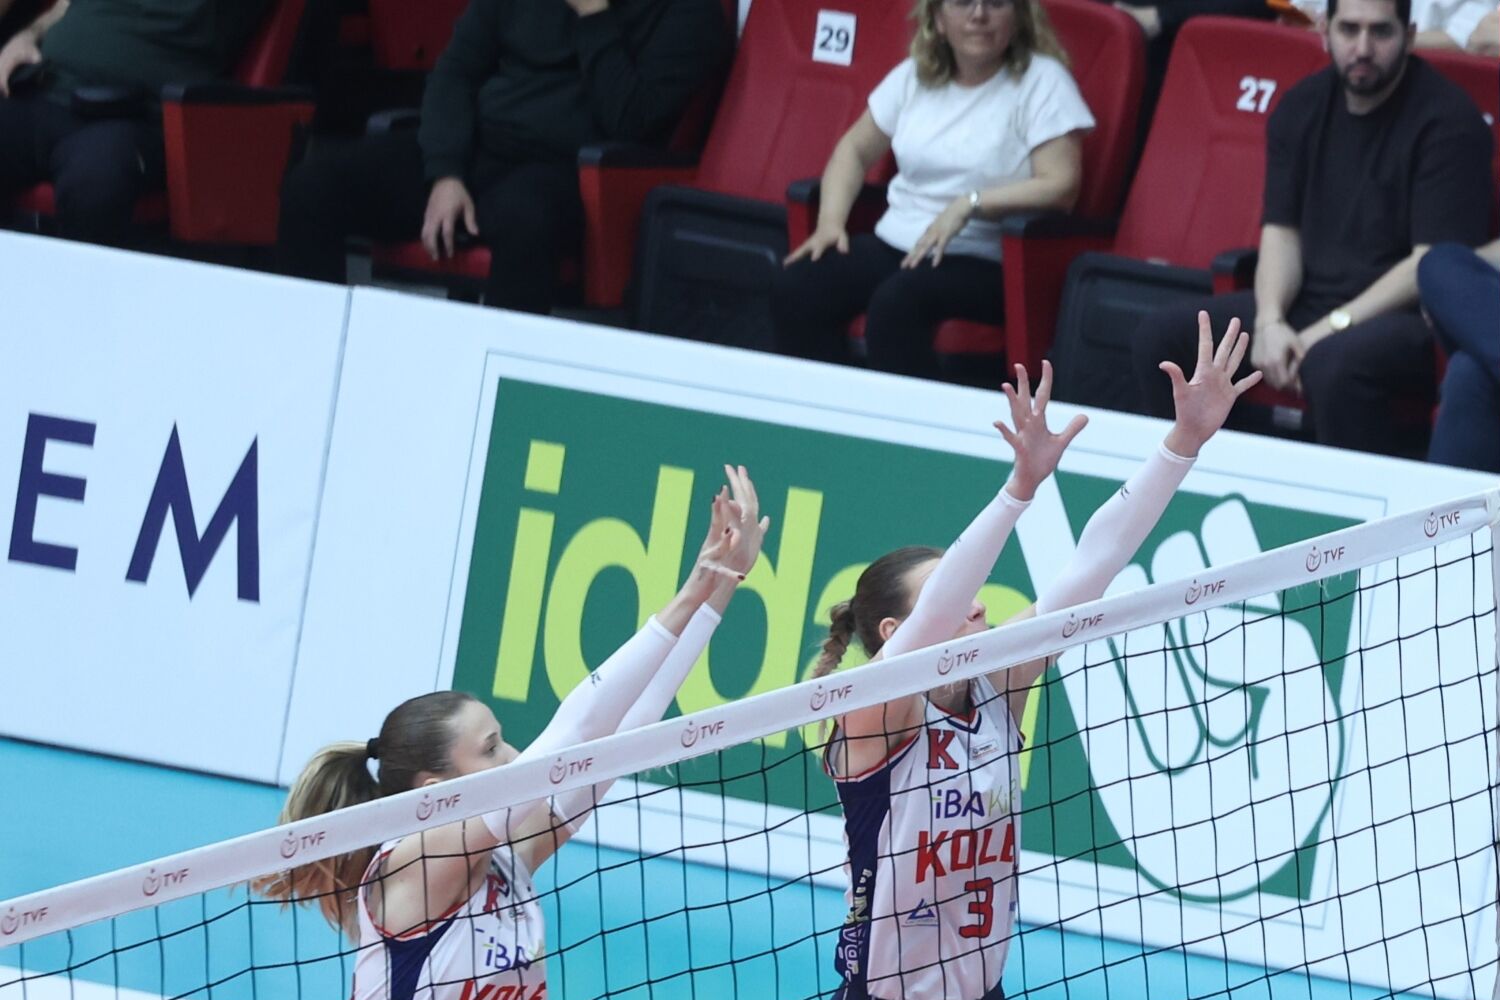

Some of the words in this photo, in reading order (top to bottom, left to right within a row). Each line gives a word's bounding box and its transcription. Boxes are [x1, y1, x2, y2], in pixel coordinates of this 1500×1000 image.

[818, 26, 851, 53] 29
[1237, 76, 1276, 113] 27
[8, 411, 260, 604] EM
[1439, 511, 1461, 529] TVF
[1323, 546, 1346, 564] TVF
[1203, 580, 1228, 598] TVF
[1080, 613, 1105, 632] TVF
[956, 649, 979, 667] TVF
[830, 685, 854, 703] TVF
[701, 720, 725, 740] TVF
[926, 728, 959, 770] K
[568, 757, 593, 776] TVF
[436, 794, 461, 812] TVF
[300, 831, 326, 850] TVF
[163, 868, 190, 885] TVF
[23, 906, 48, 926] TVF
[958, 877, 994, 939] 3
